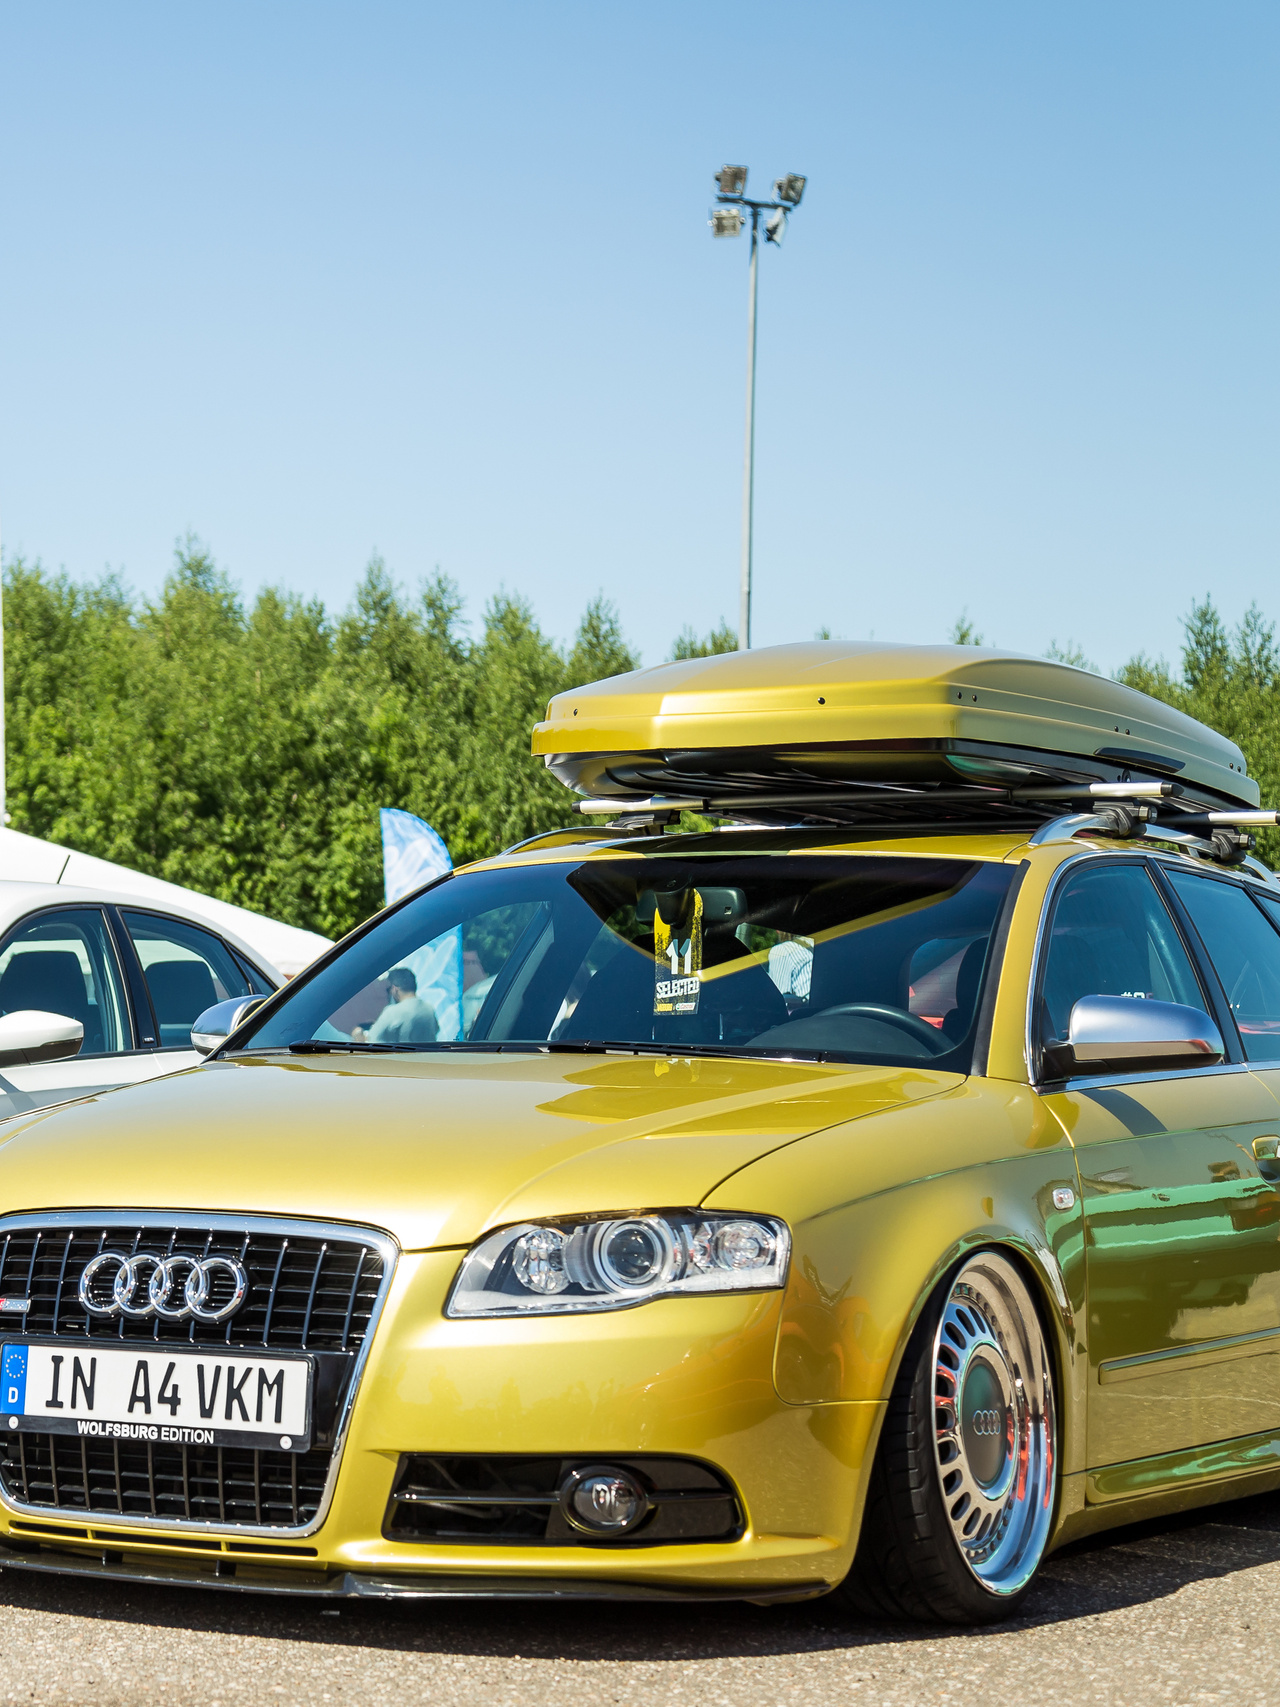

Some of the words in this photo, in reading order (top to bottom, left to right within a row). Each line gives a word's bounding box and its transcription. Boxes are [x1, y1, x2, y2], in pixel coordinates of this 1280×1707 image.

[665, 938, 692, 975] 11
[656, 977, 699, 999] SELECTED
[7, 1386, 19, 1404] D
[45, 1354, 98, 1411] IN
[127, 1359, 182, 1416] A4
[196, 1363, 285, 1424] VKM
[77, 1420, 159, 1441] WOLFSBURG
[160, 1427, 215, 1445] EDITION
